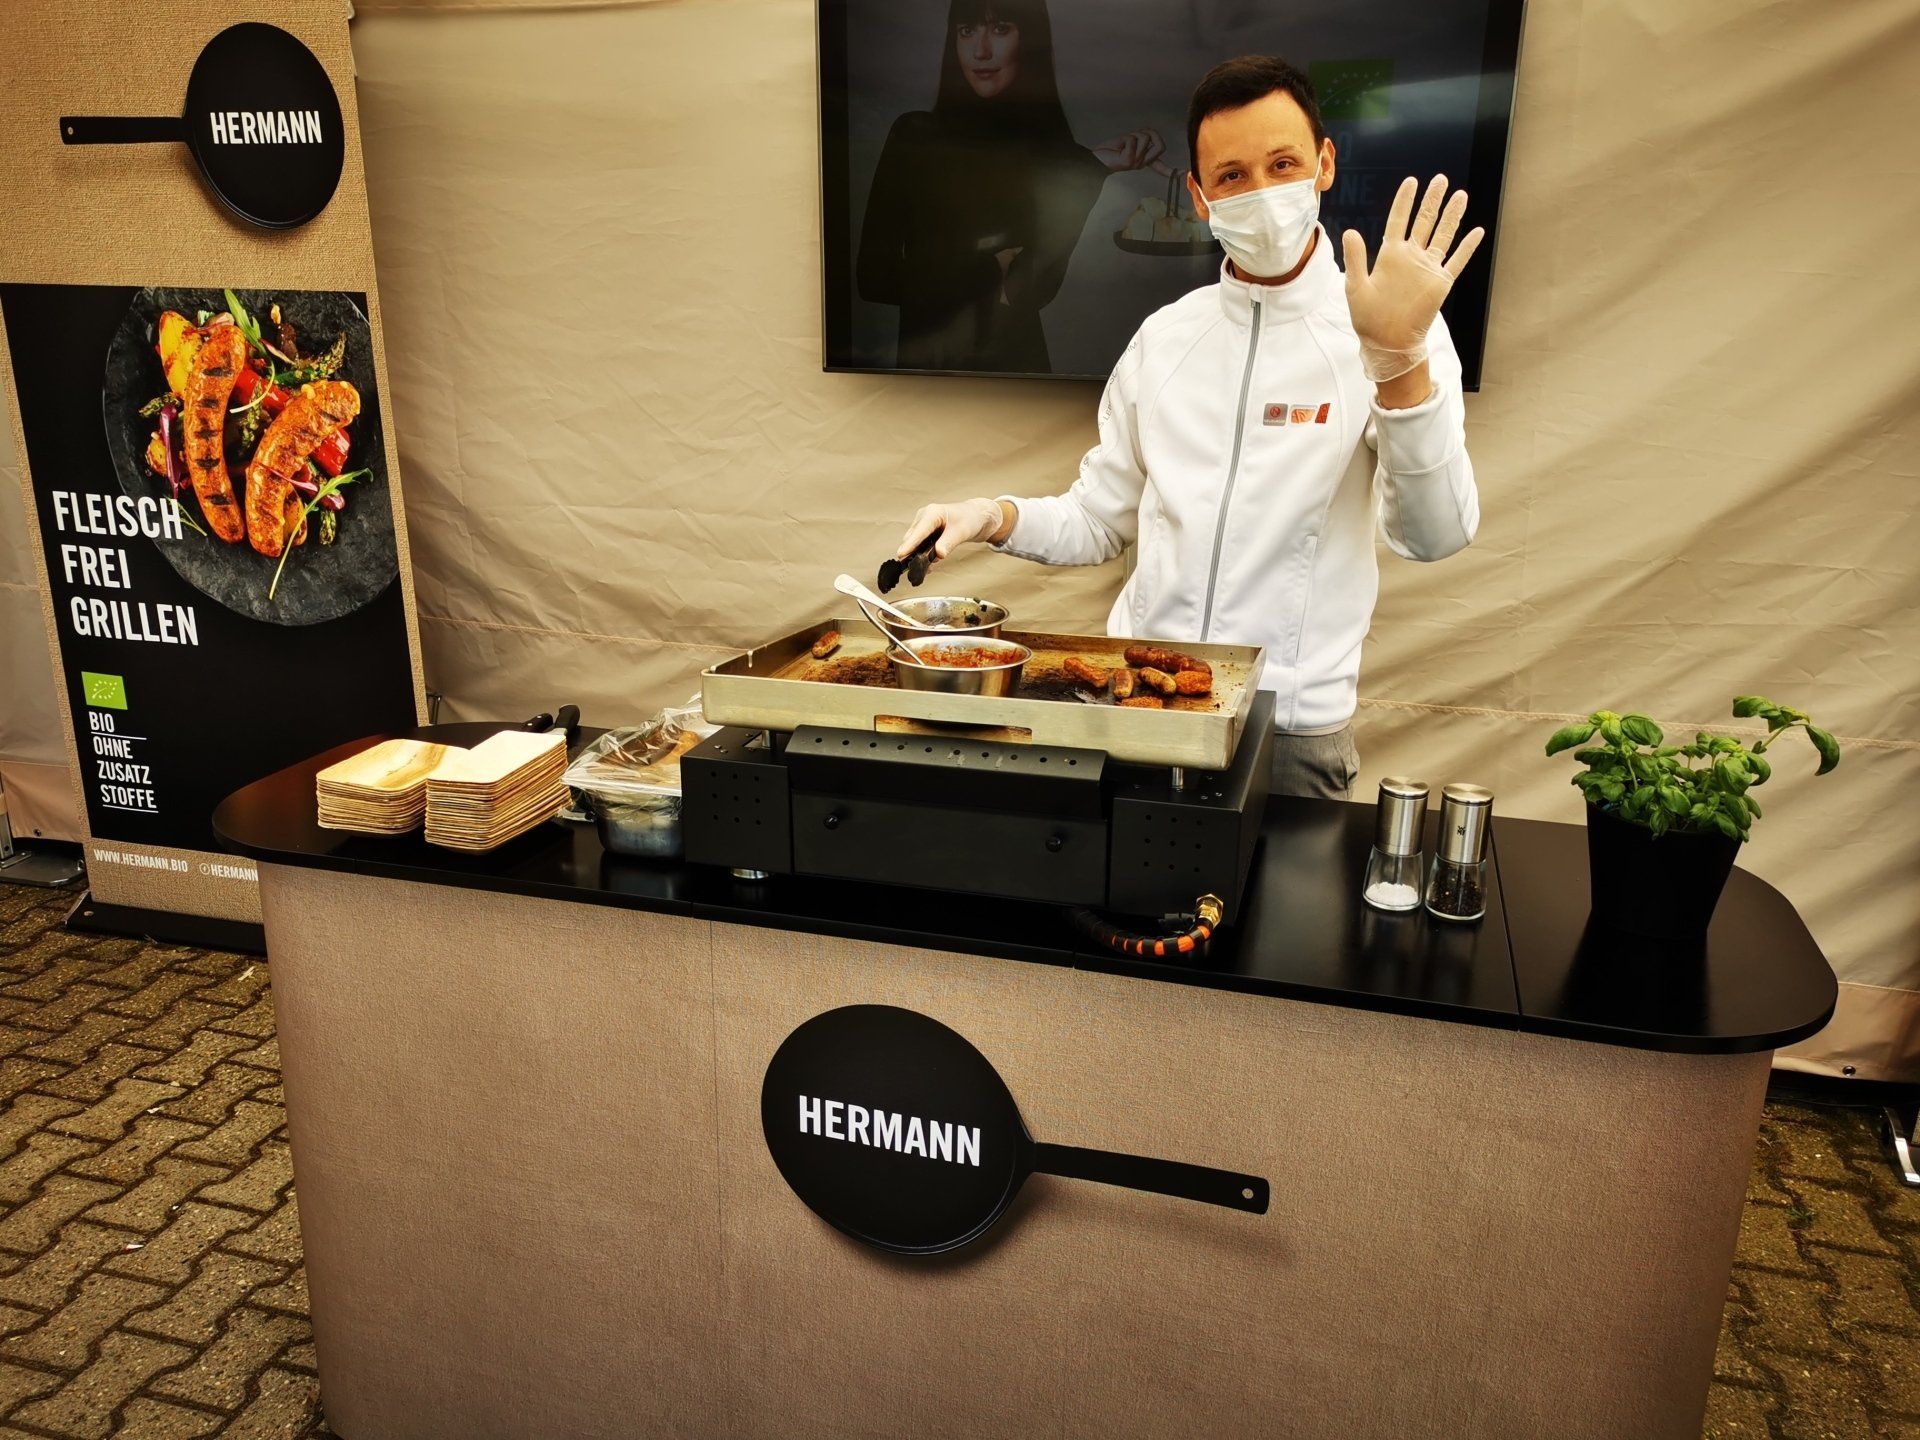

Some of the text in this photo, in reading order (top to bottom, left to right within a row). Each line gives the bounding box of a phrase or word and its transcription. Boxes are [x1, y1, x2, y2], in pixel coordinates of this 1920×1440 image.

[210, 111, 322, 145] HERMANN
[52, 490, 183, 540] FLEISCH
[61, 544, 131, 589] FREI
[70, 596, 199, 646] GRILLEN
[88, 711, 115, 733] BIO
[93, 736, 134, 760] OHNE
[96, 760, 153, 785] ZUSATZ
[100, 784, 157, 809] STOFFE
[94, 849, 188, 873] WWW.HERMANN.BIO
[798, 1095, 982, 1167] HERMANN
